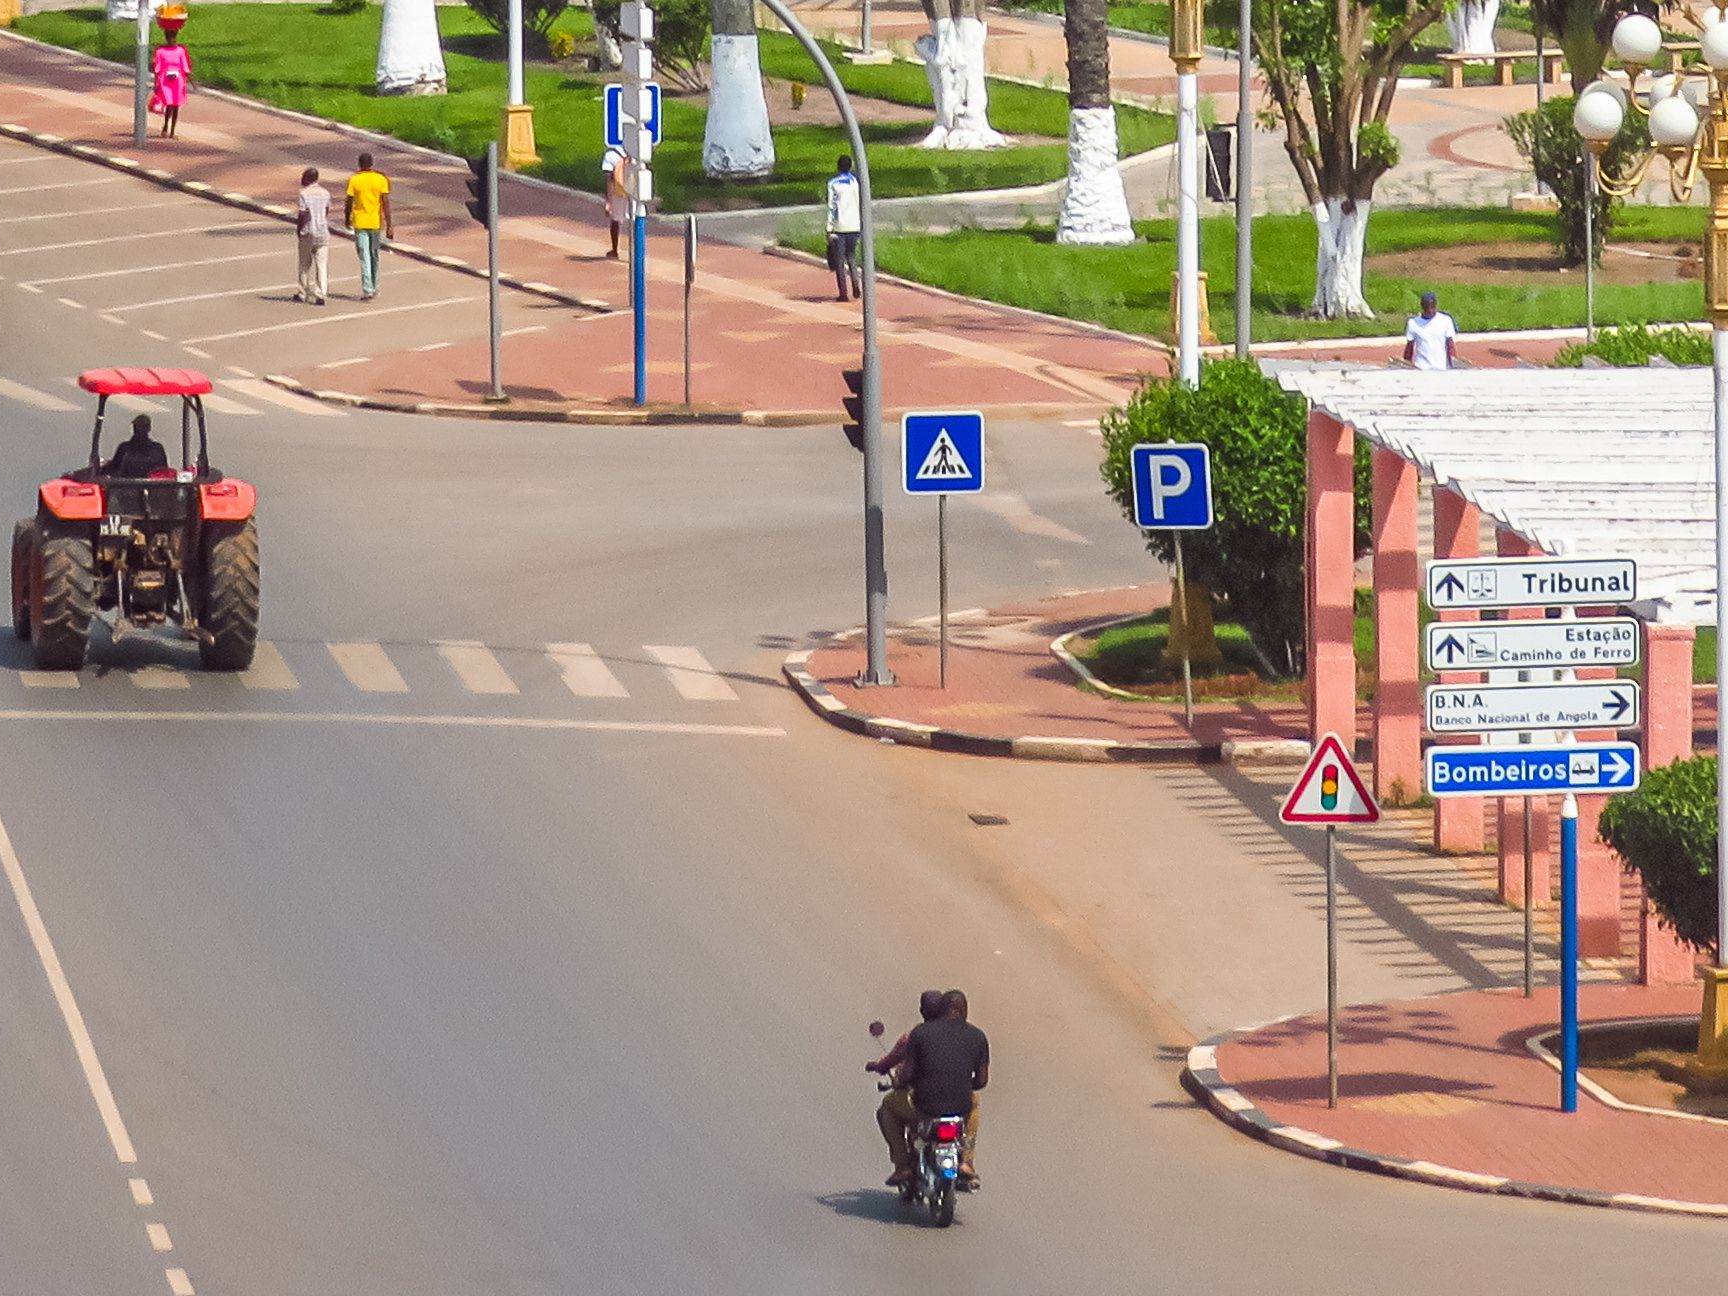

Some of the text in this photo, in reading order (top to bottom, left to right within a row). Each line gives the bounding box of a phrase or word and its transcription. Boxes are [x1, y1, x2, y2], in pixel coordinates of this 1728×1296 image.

[1148, 454, 1192, 520] P
[1522, 570, 1630, 595] Tribunal
[1565, 627, 1631, 645] Estação
[1500, 646, 1631, 662] Caminho de Ferro
[1435, 693, 1489, 709] B.N.A.
[1435, 710, 1599, 726] Banco Nacional de Angola
[1434, 758, 1567, 785] Bombeiros
